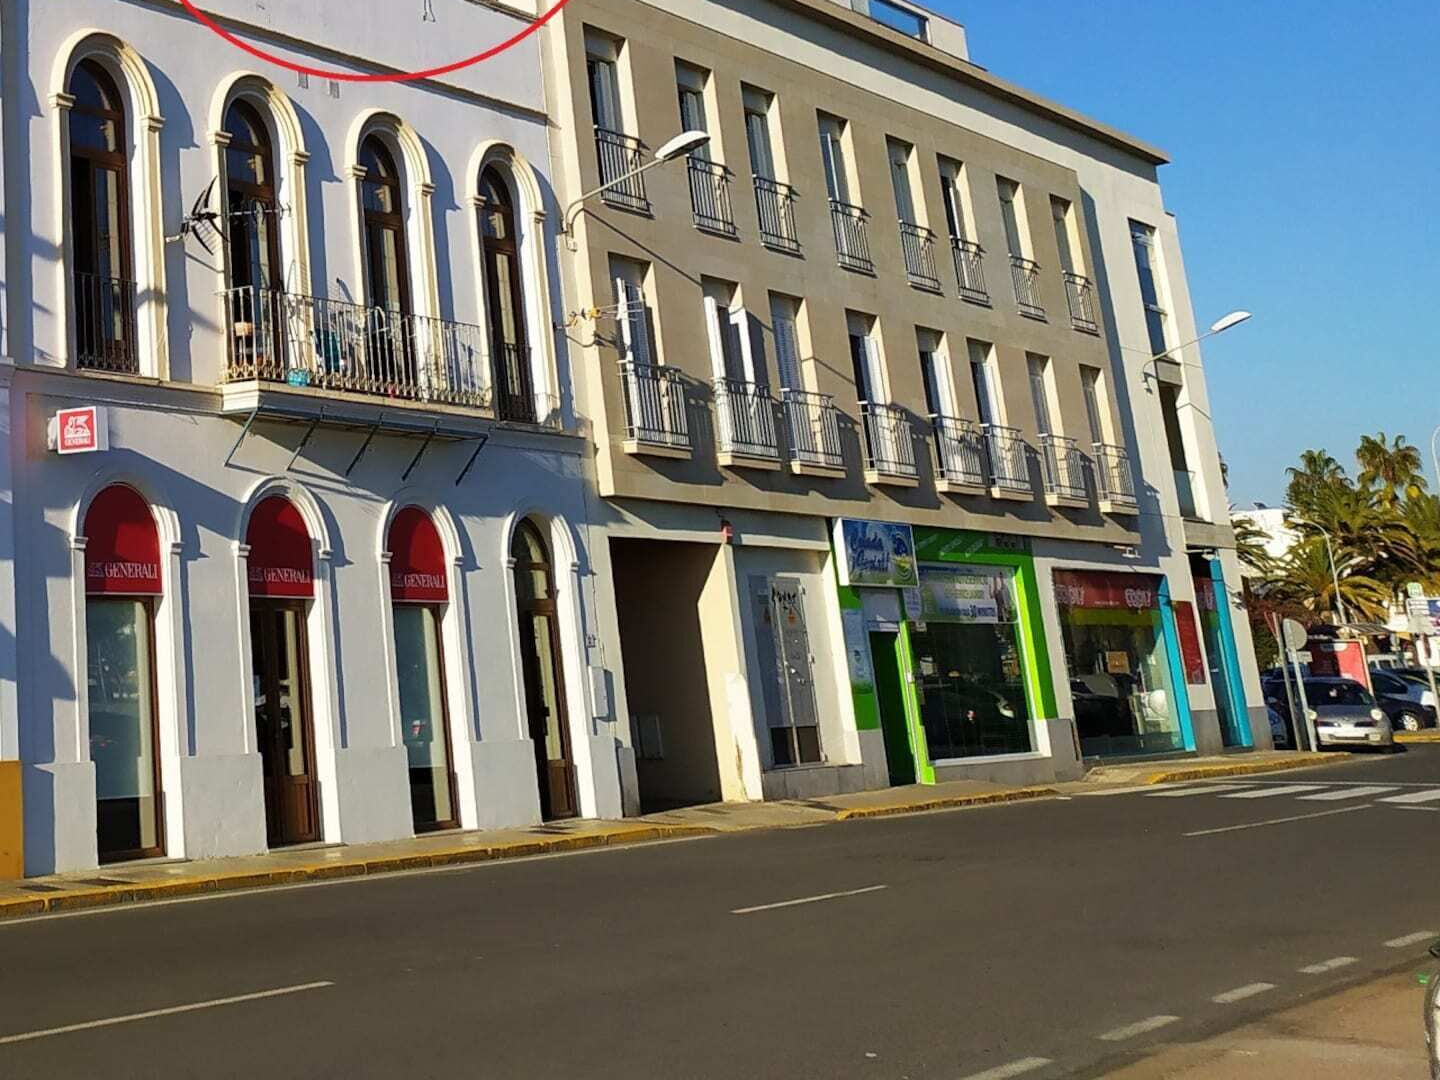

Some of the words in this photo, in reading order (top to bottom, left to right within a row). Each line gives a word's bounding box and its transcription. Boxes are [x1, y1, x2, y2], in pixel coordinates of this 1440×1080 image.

[104, 561, 158, 579] GENERALI
[263, 567, 311, 584] GENERALI
[404, 573, 446, 588] GENERALI
